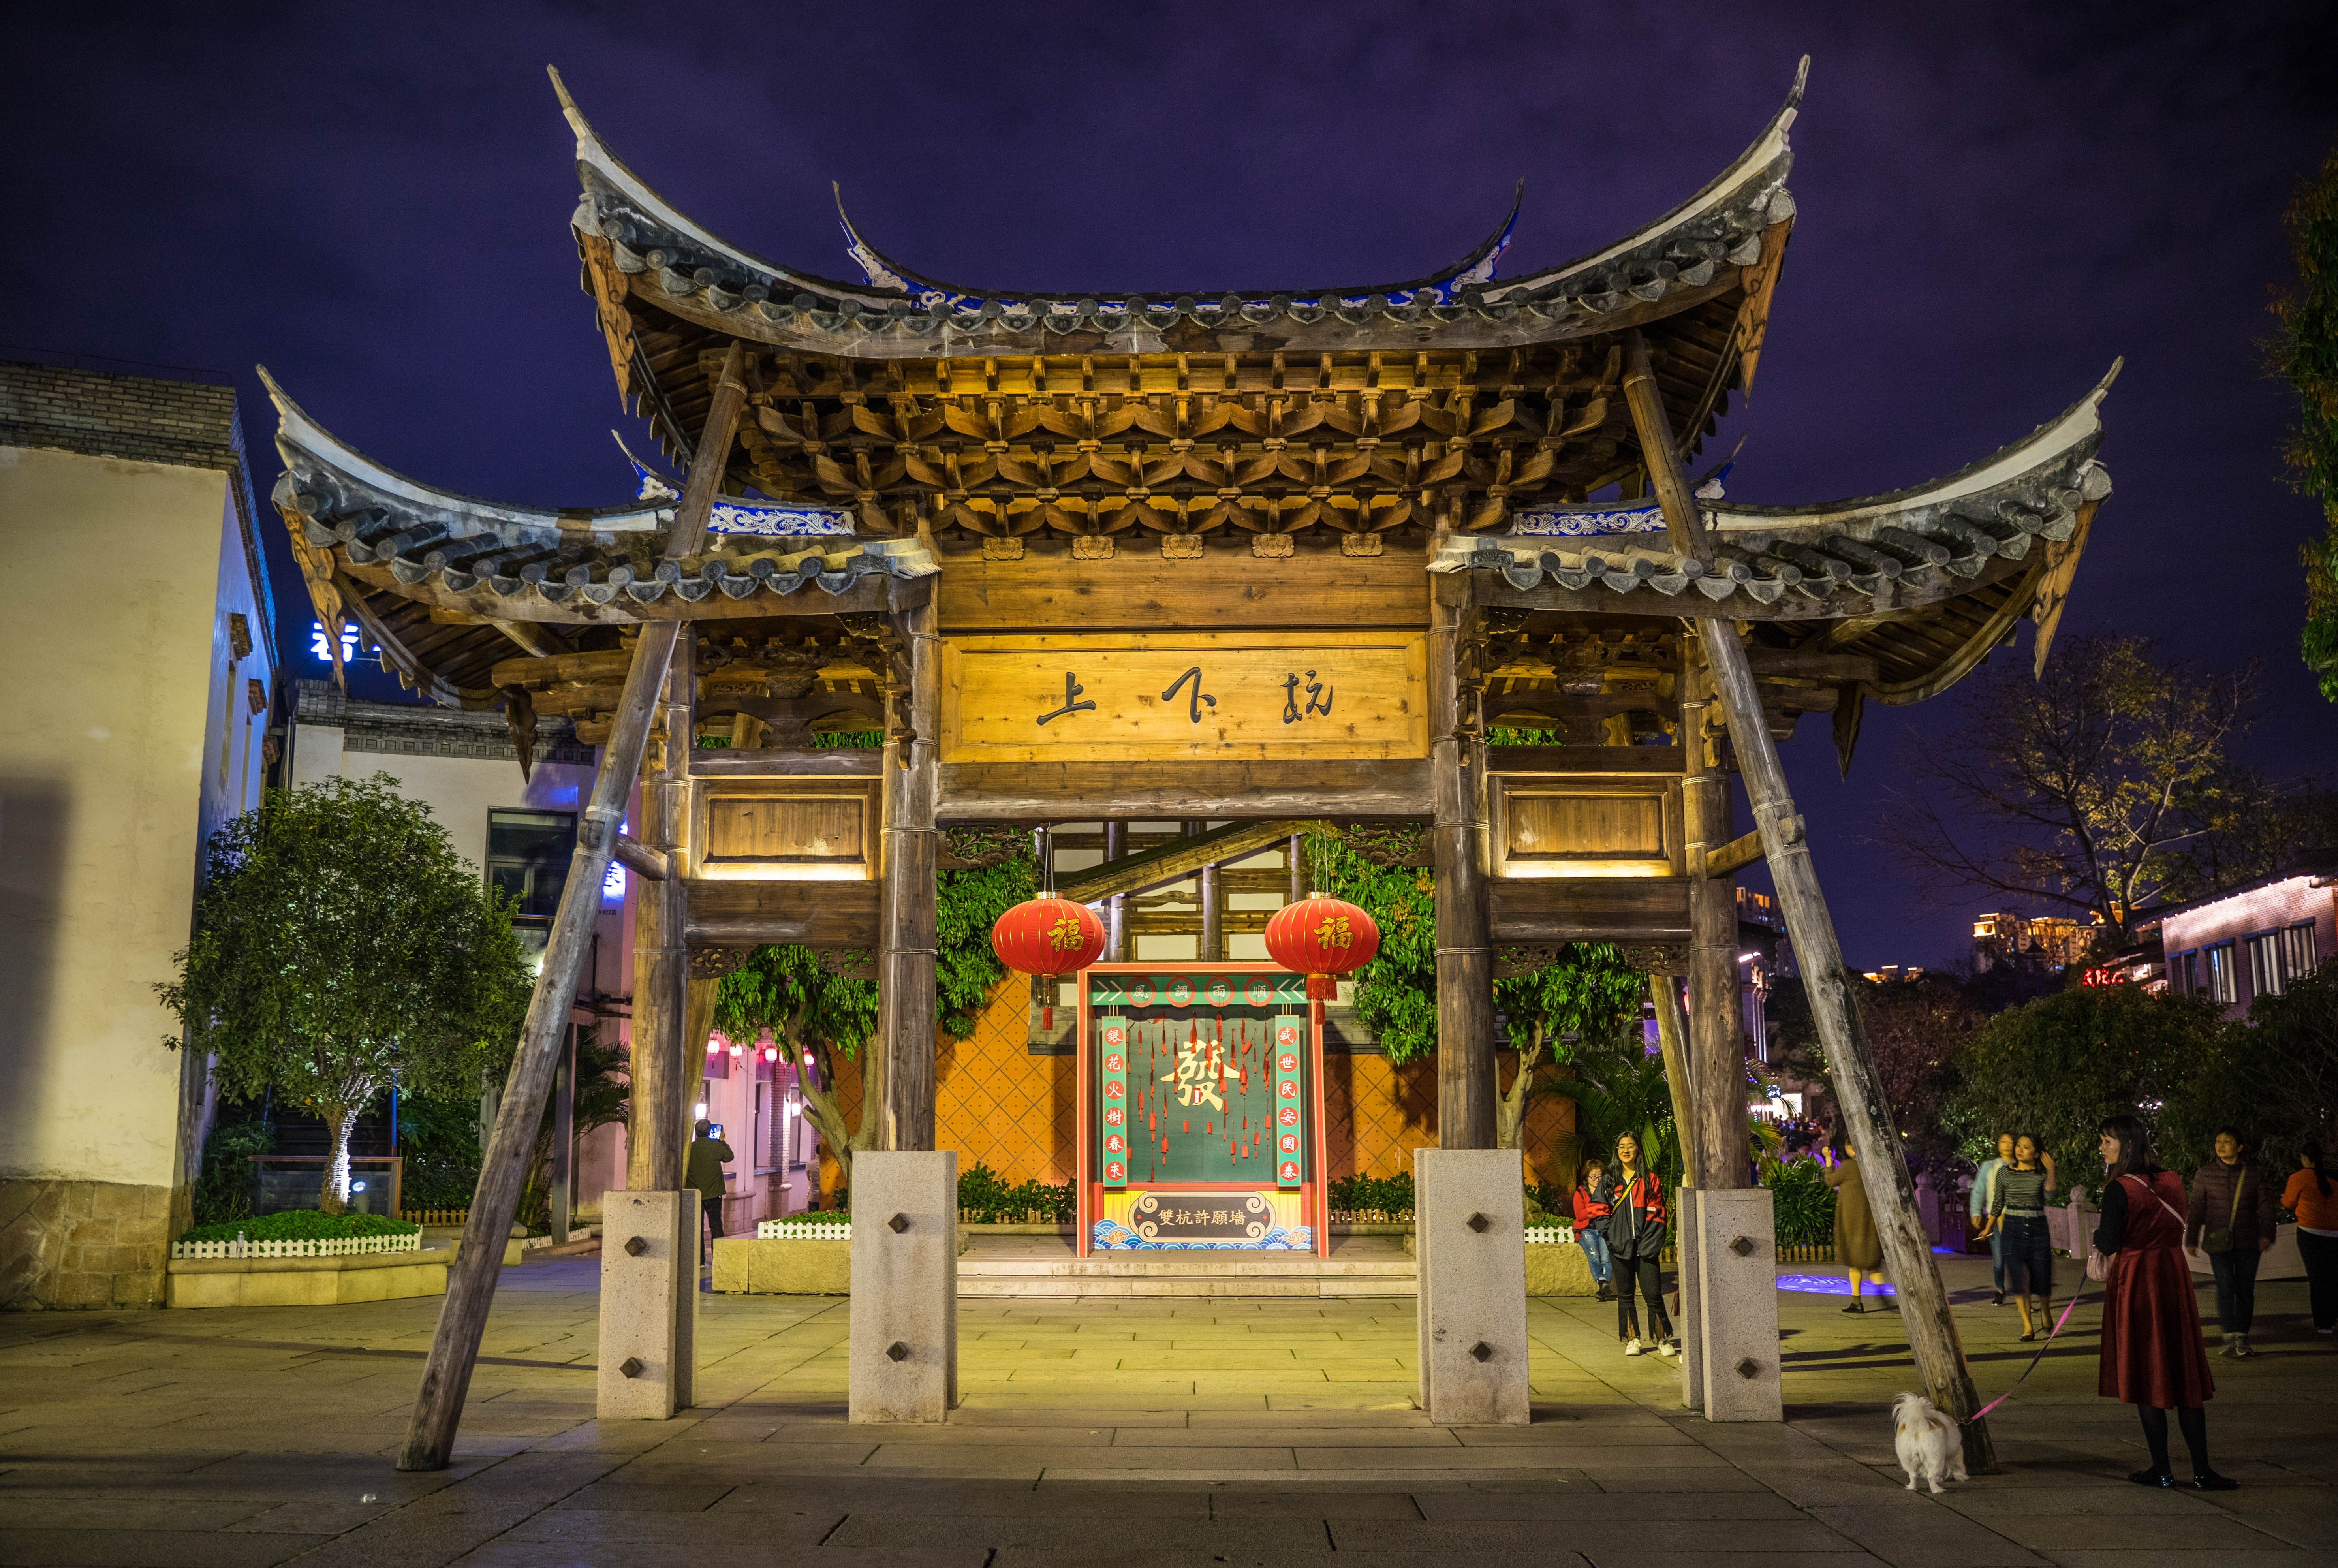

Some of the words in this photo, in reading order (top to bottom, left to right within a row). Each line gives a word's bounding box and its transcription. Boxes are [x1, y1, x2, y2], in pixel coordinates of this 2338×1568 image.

[1046, 918, 1085, 952] 福
[1314, 916, 1354, 950] 福
[1133, 984, 1267, 999] 風調雨順
[1160, 1039, 1240, 1111] 發
[1106, 1029, 1123, 1179] 銀花火樹春來
[1279, 1027, 1297, 1179] 盛世民安國泰
